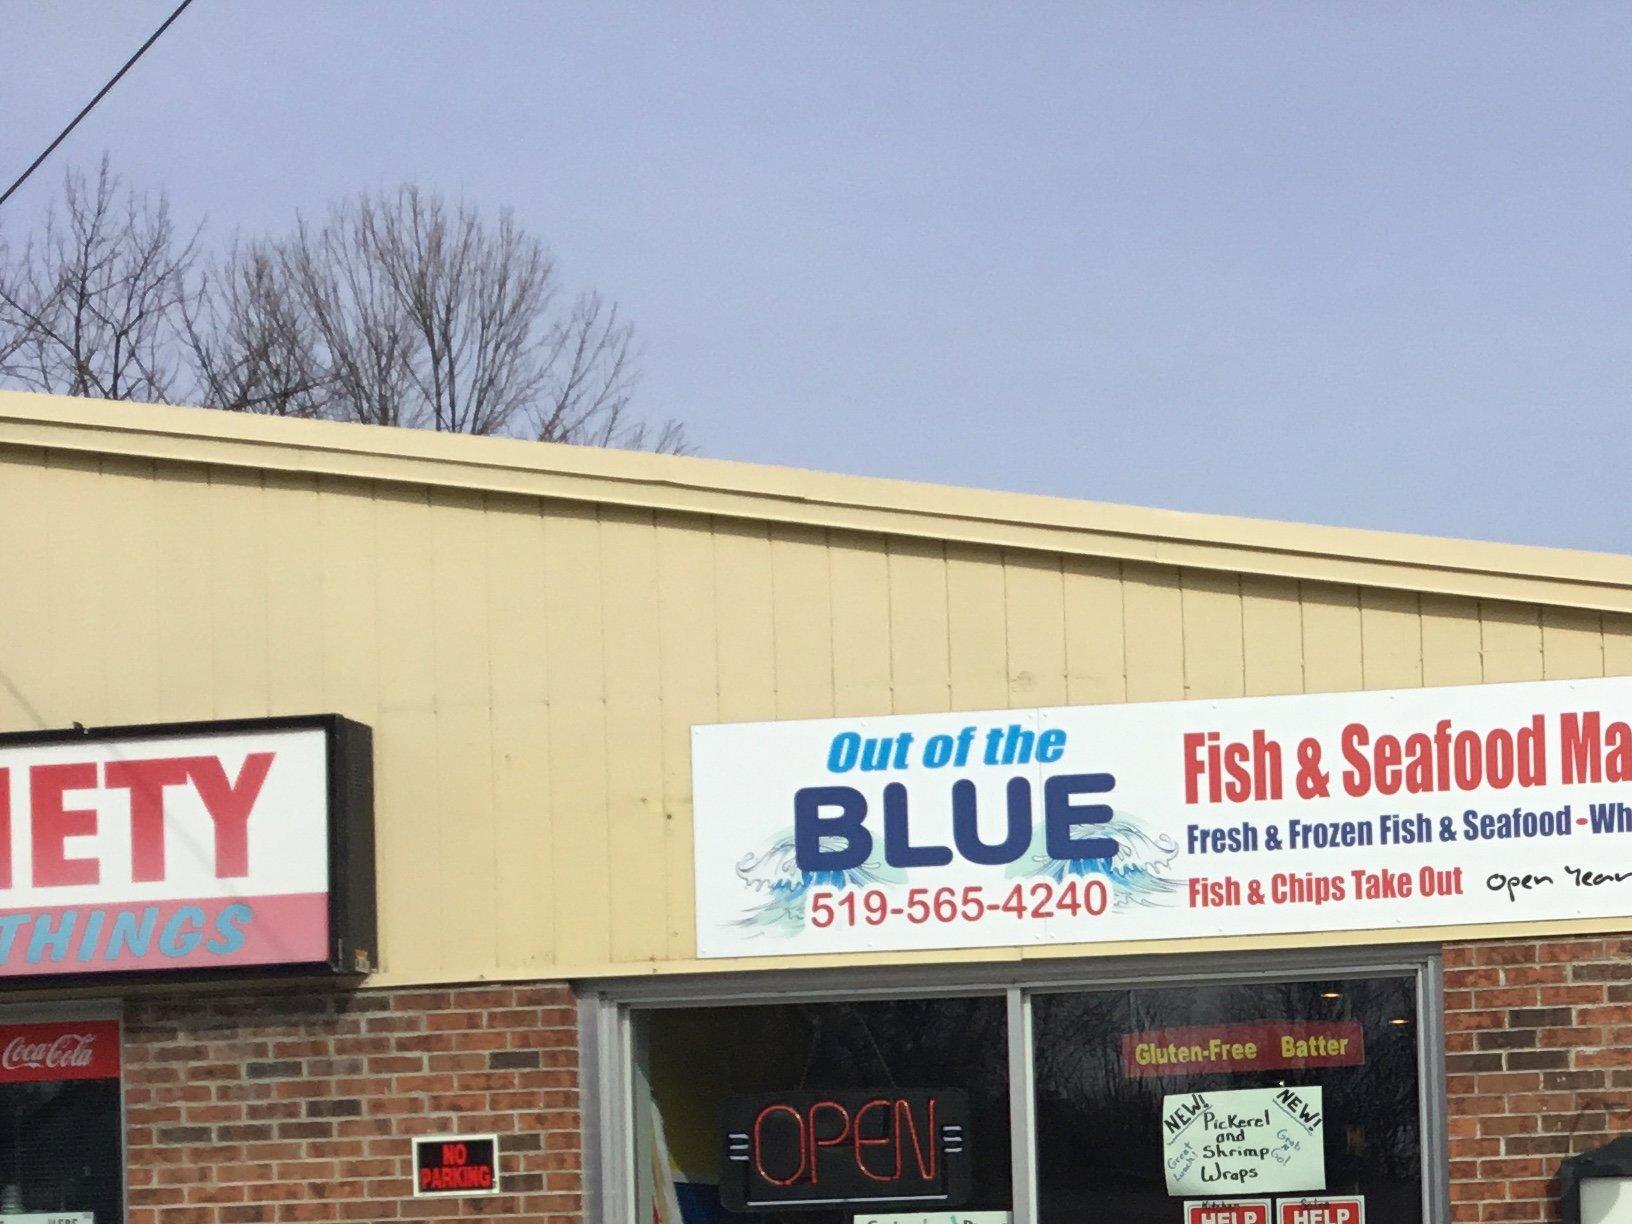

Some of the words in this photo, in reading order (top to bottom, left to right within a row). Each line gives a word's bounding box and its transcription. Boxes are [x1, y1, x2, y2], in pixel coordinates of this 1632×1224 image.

[827, 731, 914, 773] Out
[922, 726, 977, 769] of
[983, 724, 1067, 765] the
[1184, 729, 1283, 804] Fish
[1296, 737, 1331, 799] &
[1341, 713, 1547, 797] Seafood
[794, 772, 1120, 872] BLUE
[1187, 822, 1258, 854] Fresh
[1265, 825, 1283, 850] &
[1289, 819, 1373, 849] Frozen
[1379, 813, 1432, 845] Fish
[1439, 816, 1457, 842] &
[1463, 805, 1572, 841] Seafood
[810, 879, 1108, 928] 519-565-4240
[1189, 876, 1241, 908] Fish
[1247, 879, 1265, 905] &
[1271, 872, 1346, 905] Chips
[1351, 868, 1413, 900] Take
[1419, 866, 1464, 897] Out
[0, 902, 255, 966] THINGS
[1135, 1039, 1258, 1066] Gluten-Free
[1280, 1035, 1349, 1058] Batter
[1163, 1093, 1211, 1134] NEW!
[1275, 1088, 1323, 1132] NEW!
[442, 1143, 468, 1165] NO
[754, 1098, 937, 1186] OPEN
[1202, 1144, 1270, 1160] Shrimp
[1216, 1129, 1246, 1144] and
[421, 1166, 492, 1189] PARKING
[1200, 1162, 1259, 1184] Wraps
